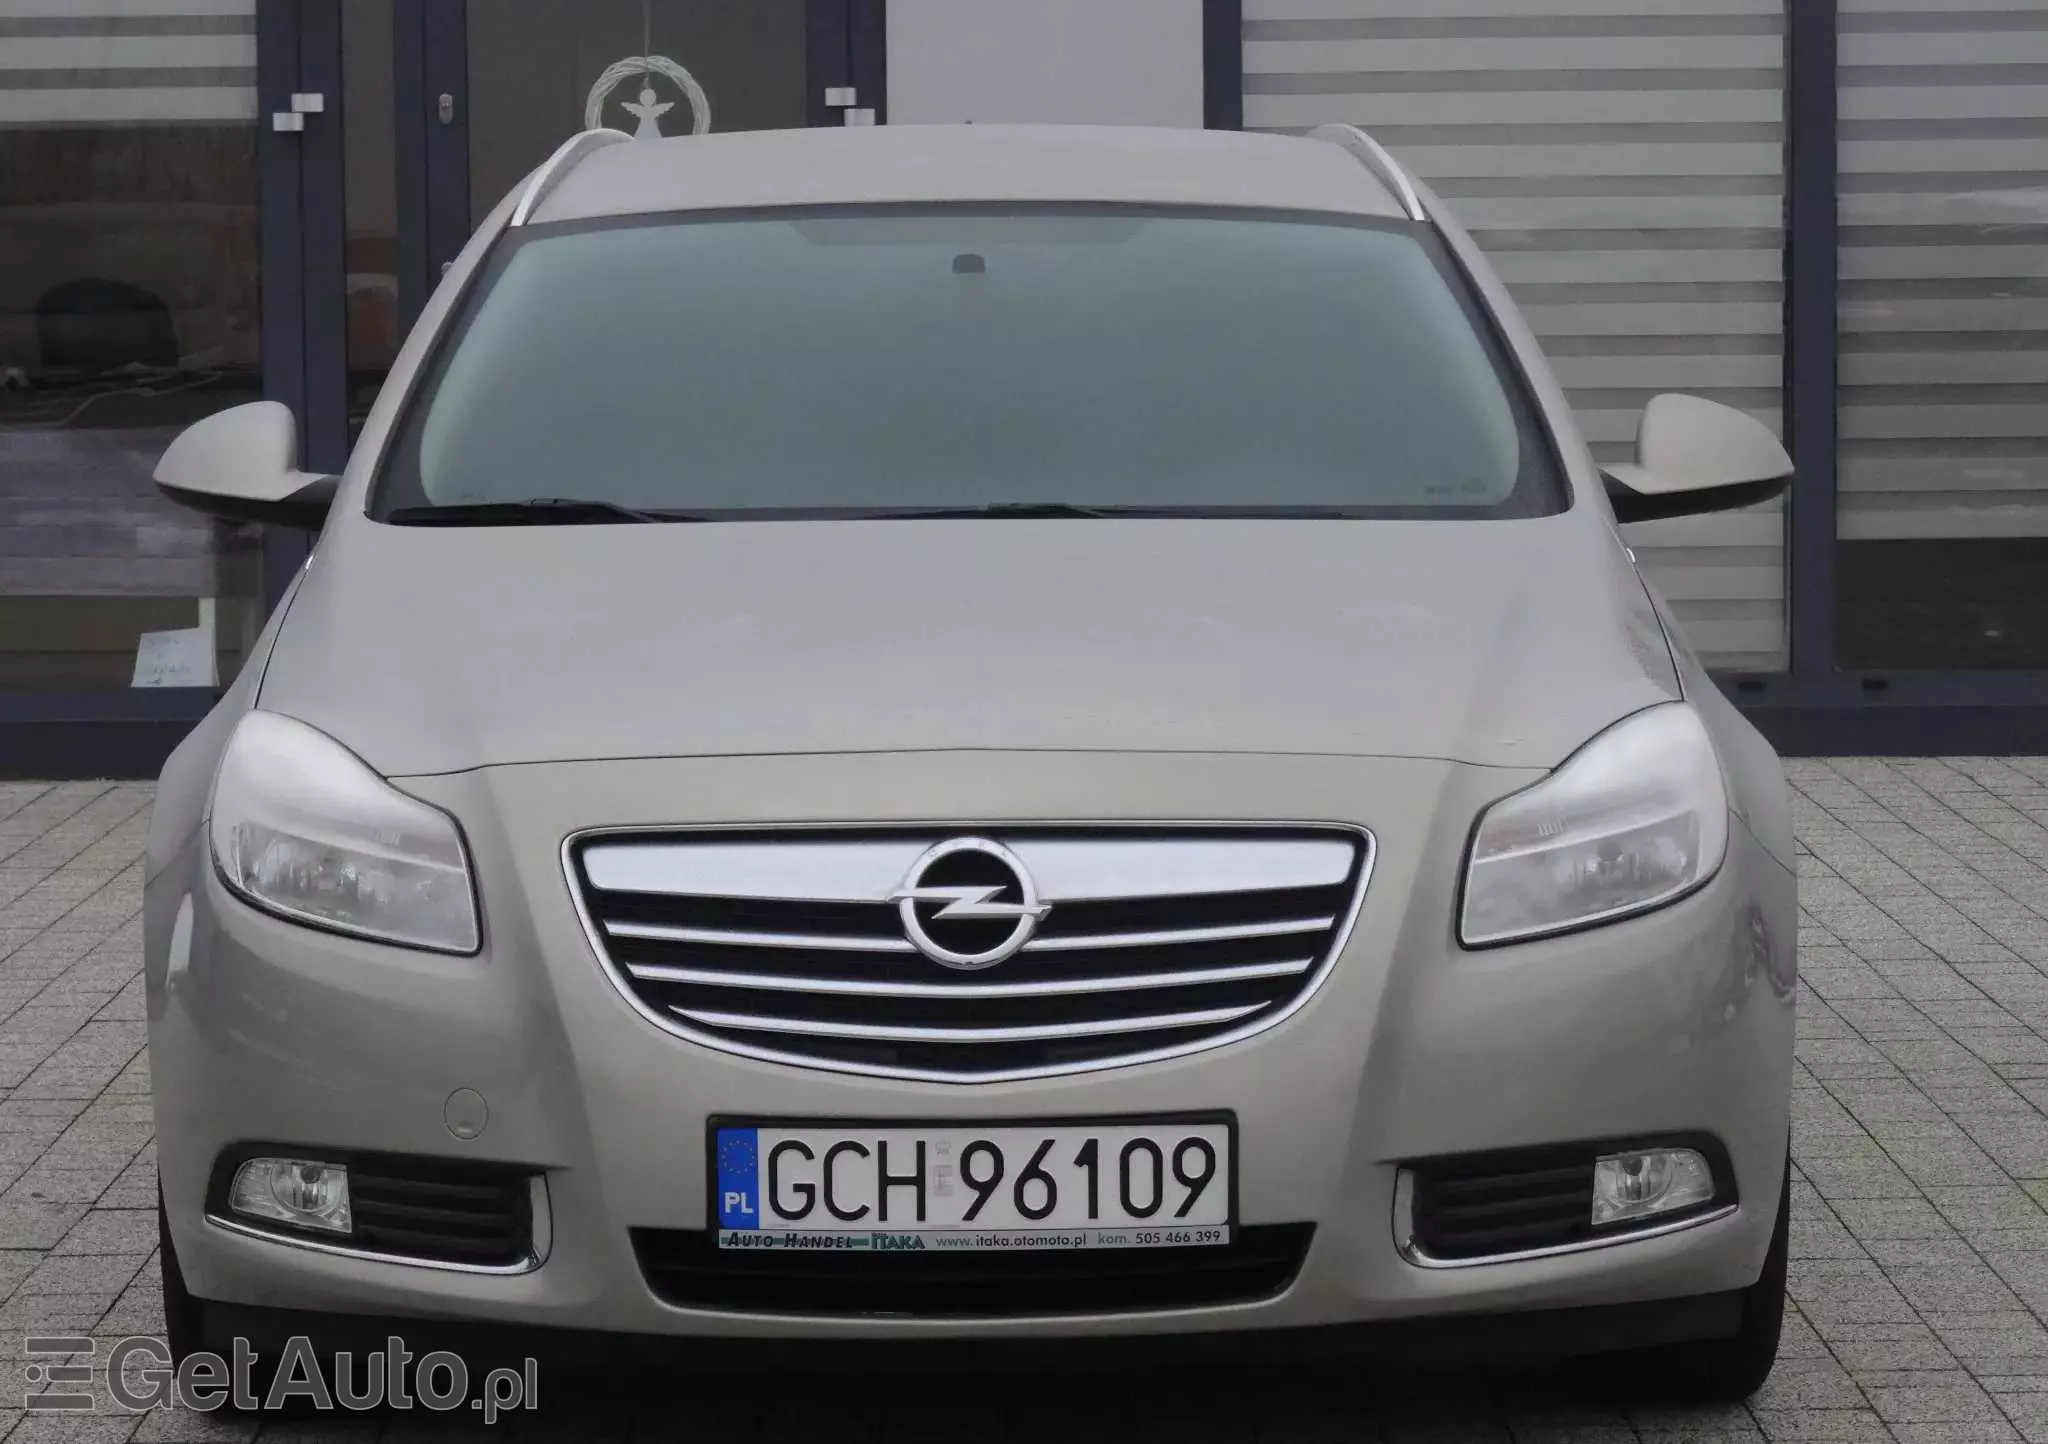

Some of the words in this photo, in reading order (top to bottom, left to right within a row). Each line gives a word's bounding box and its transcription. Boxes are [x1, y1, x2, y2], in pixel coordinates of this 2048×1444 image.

[768, 1140, 927, 1222] GCH
[959, 1136, 1216, 1221] 96109
[724, 1192, 754, 1214] PL
[871, 1234, 926, 1250] ITAKA
[1097, 1231, 1131, 1245] kom.
[1135, 1232, 1161, 1244] 505
[1165, 1231, 1191, 1243] 466
[1195, 1230, 1221, 1242] 399
